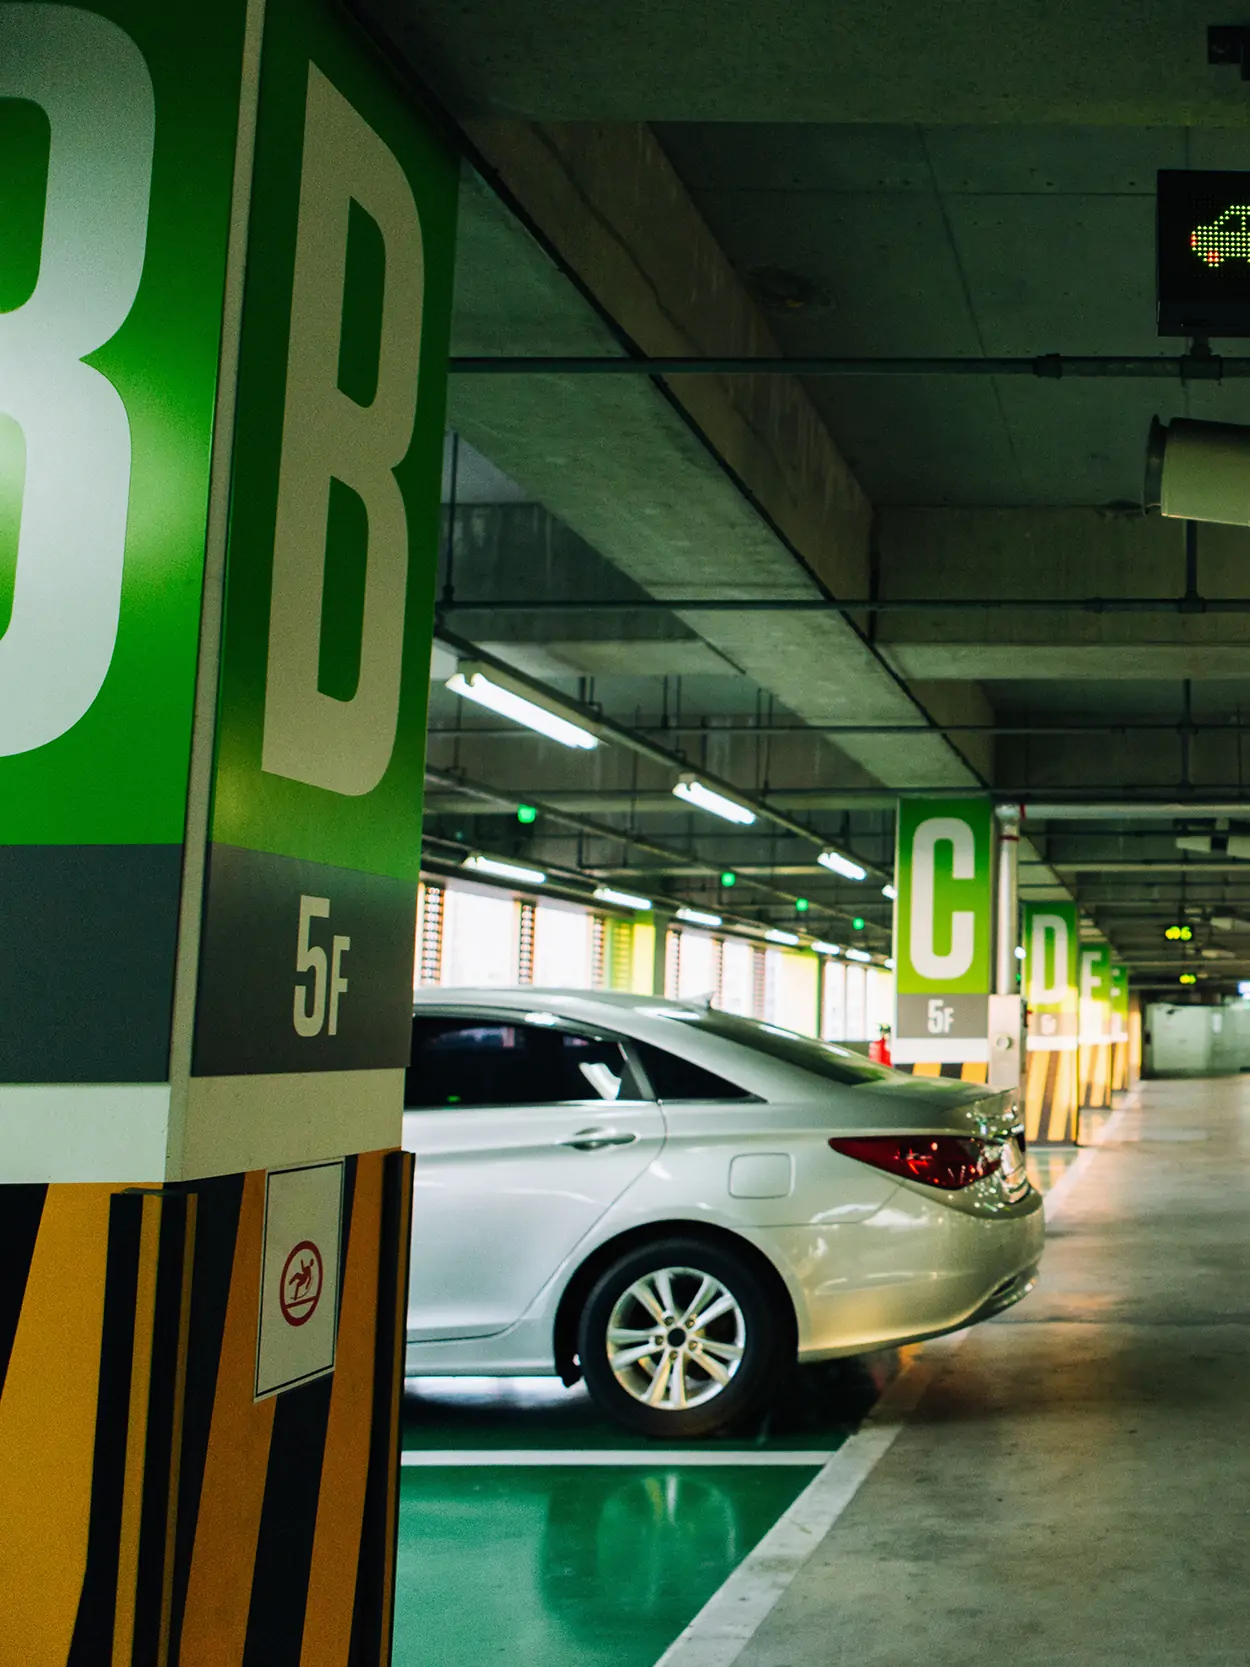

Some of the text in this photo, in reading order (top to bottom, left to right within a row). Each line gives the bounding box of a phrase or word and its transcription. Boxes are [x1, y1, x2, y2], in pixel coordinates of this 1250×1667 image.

[262, 57, 425, 798] B
[292, 895, 351, 1038] 5F
[910, 817, 975, 980] C
[1031, 914, 1068, 1004] D
[927, 999, 954, 1033] 5F
